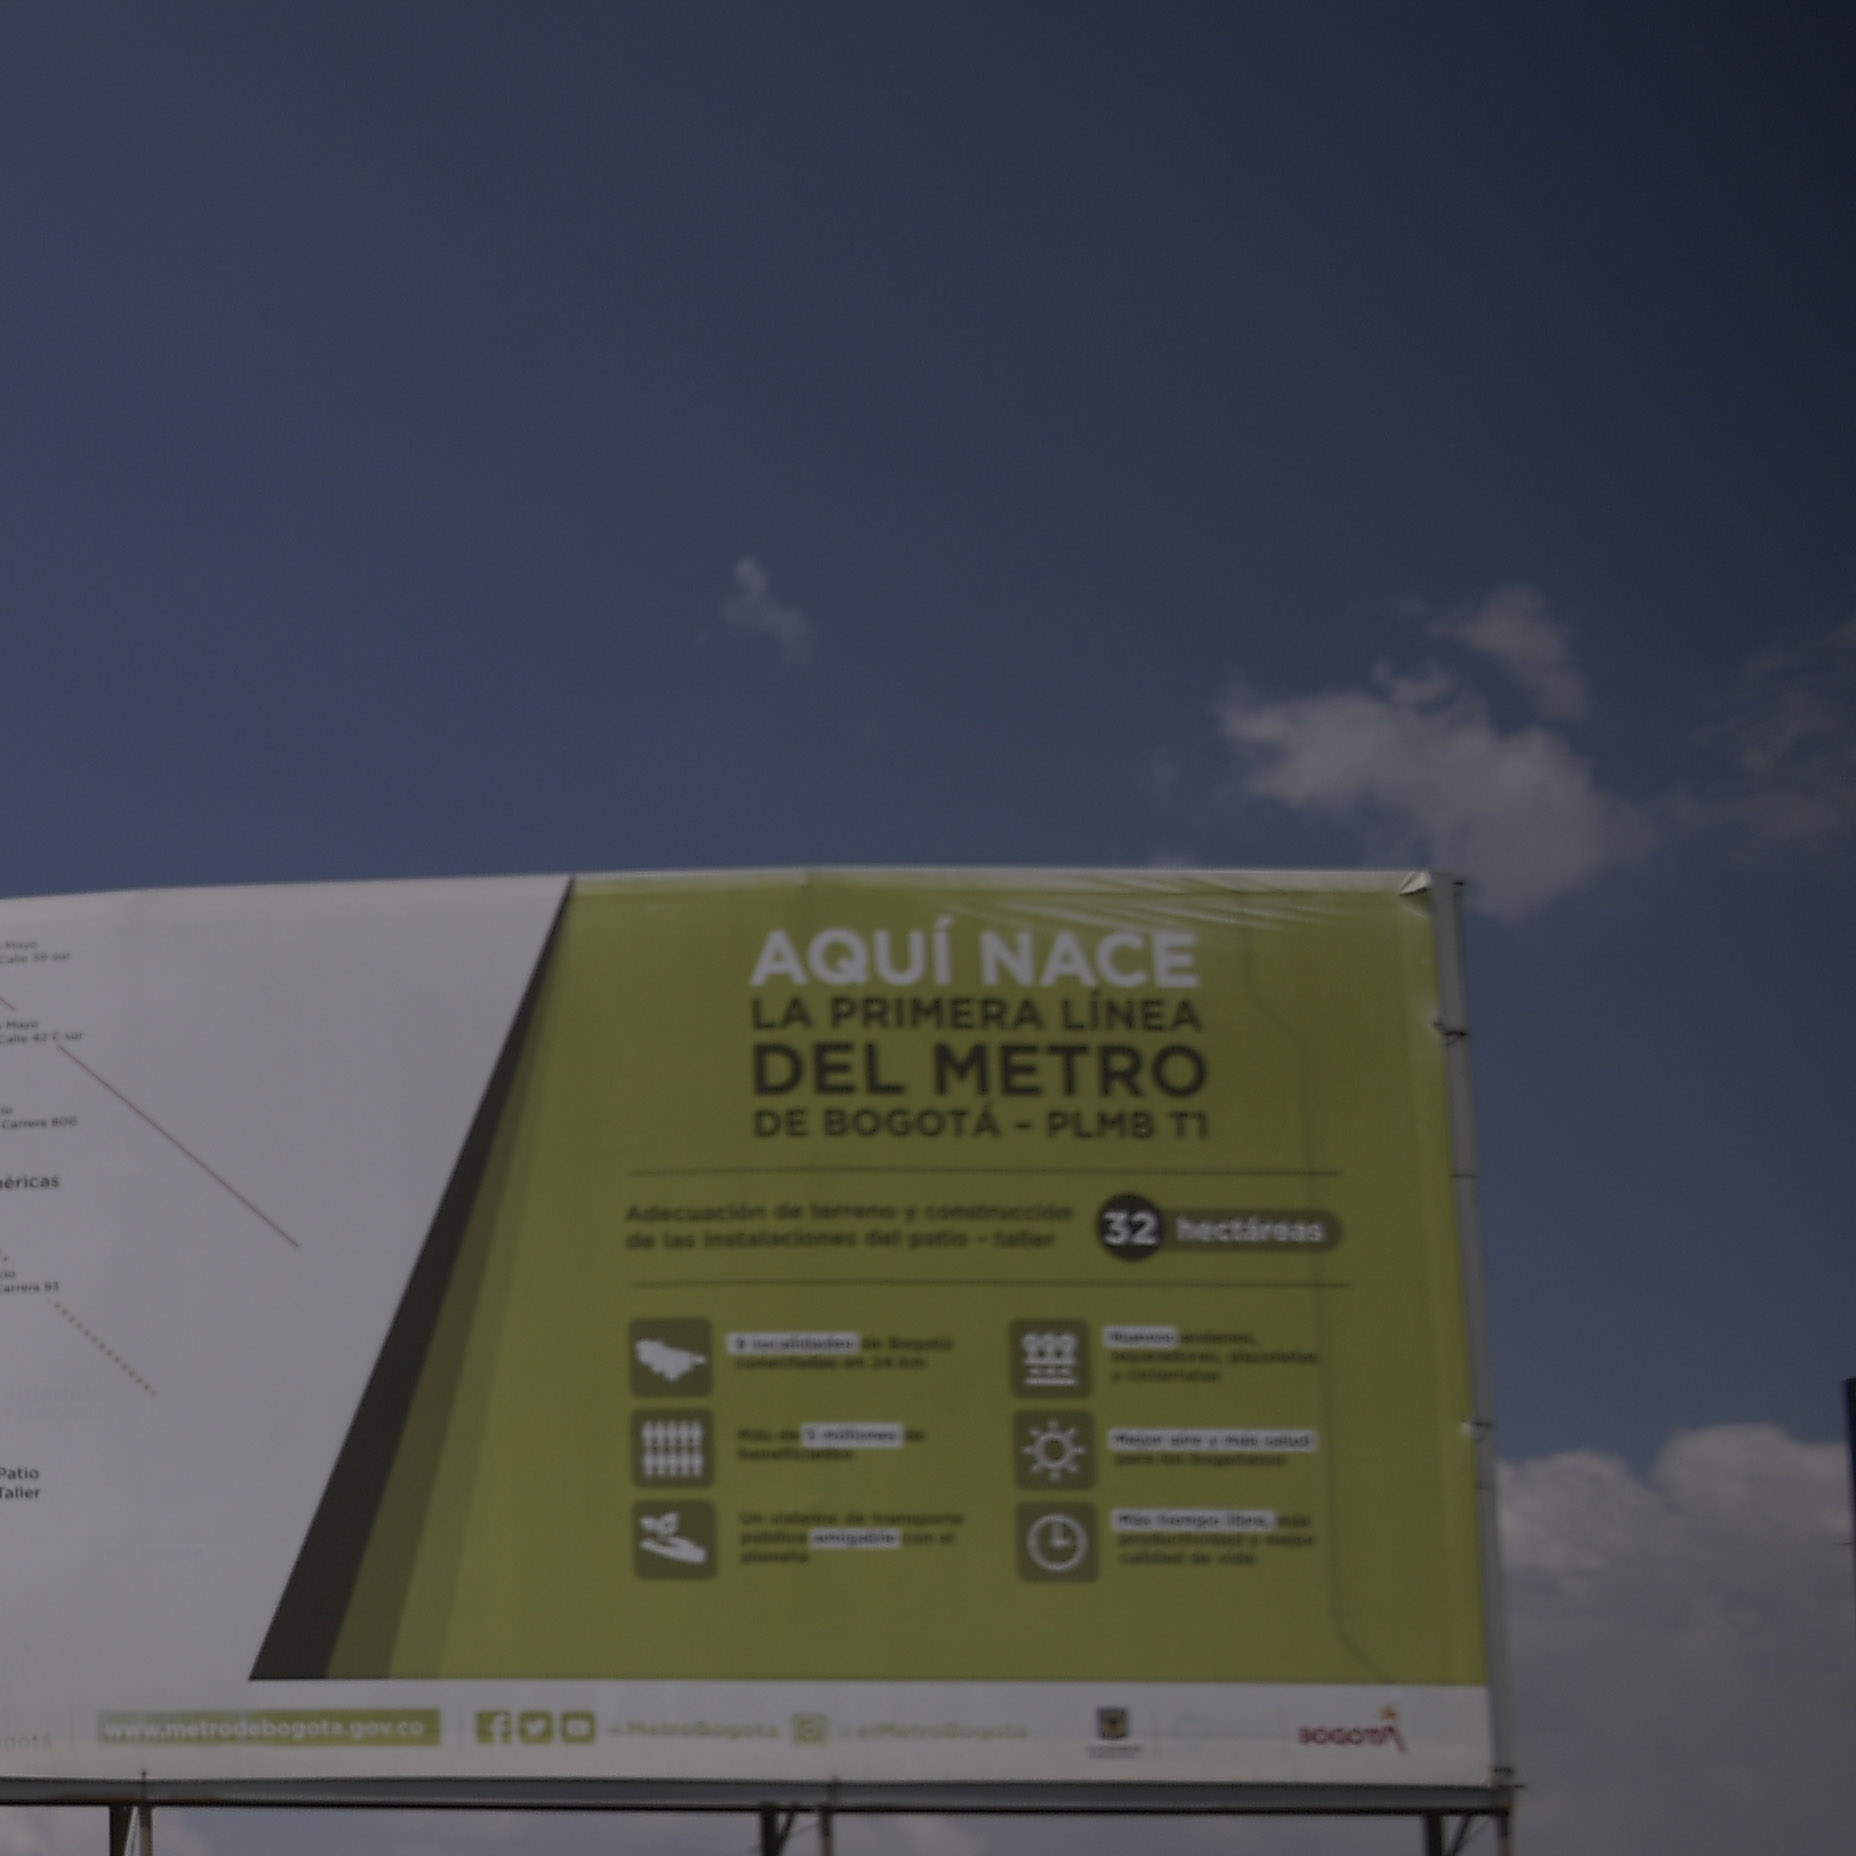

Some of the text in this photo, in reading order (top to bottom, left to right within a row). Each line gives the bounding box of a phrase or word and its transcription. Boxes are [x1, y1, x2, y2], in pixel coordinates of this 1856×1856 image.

[749, 915, 1200, 988] AQUÍ NACE
[751, 990, 1203, 1032] LA PRIMERA LÍNEA
[753, 1042, 1207, 1098] DEL METRO
[754, 1109, 809, 1137] DE
[824, 1103, 1000, 1138] BOGOTÁ
[1047, 1110, 1155, 1139] PLMB
[1103, 1211, 1160, 1245] 32
[103, 1719, 426, 1740] www.metrodebogota.gov.co
